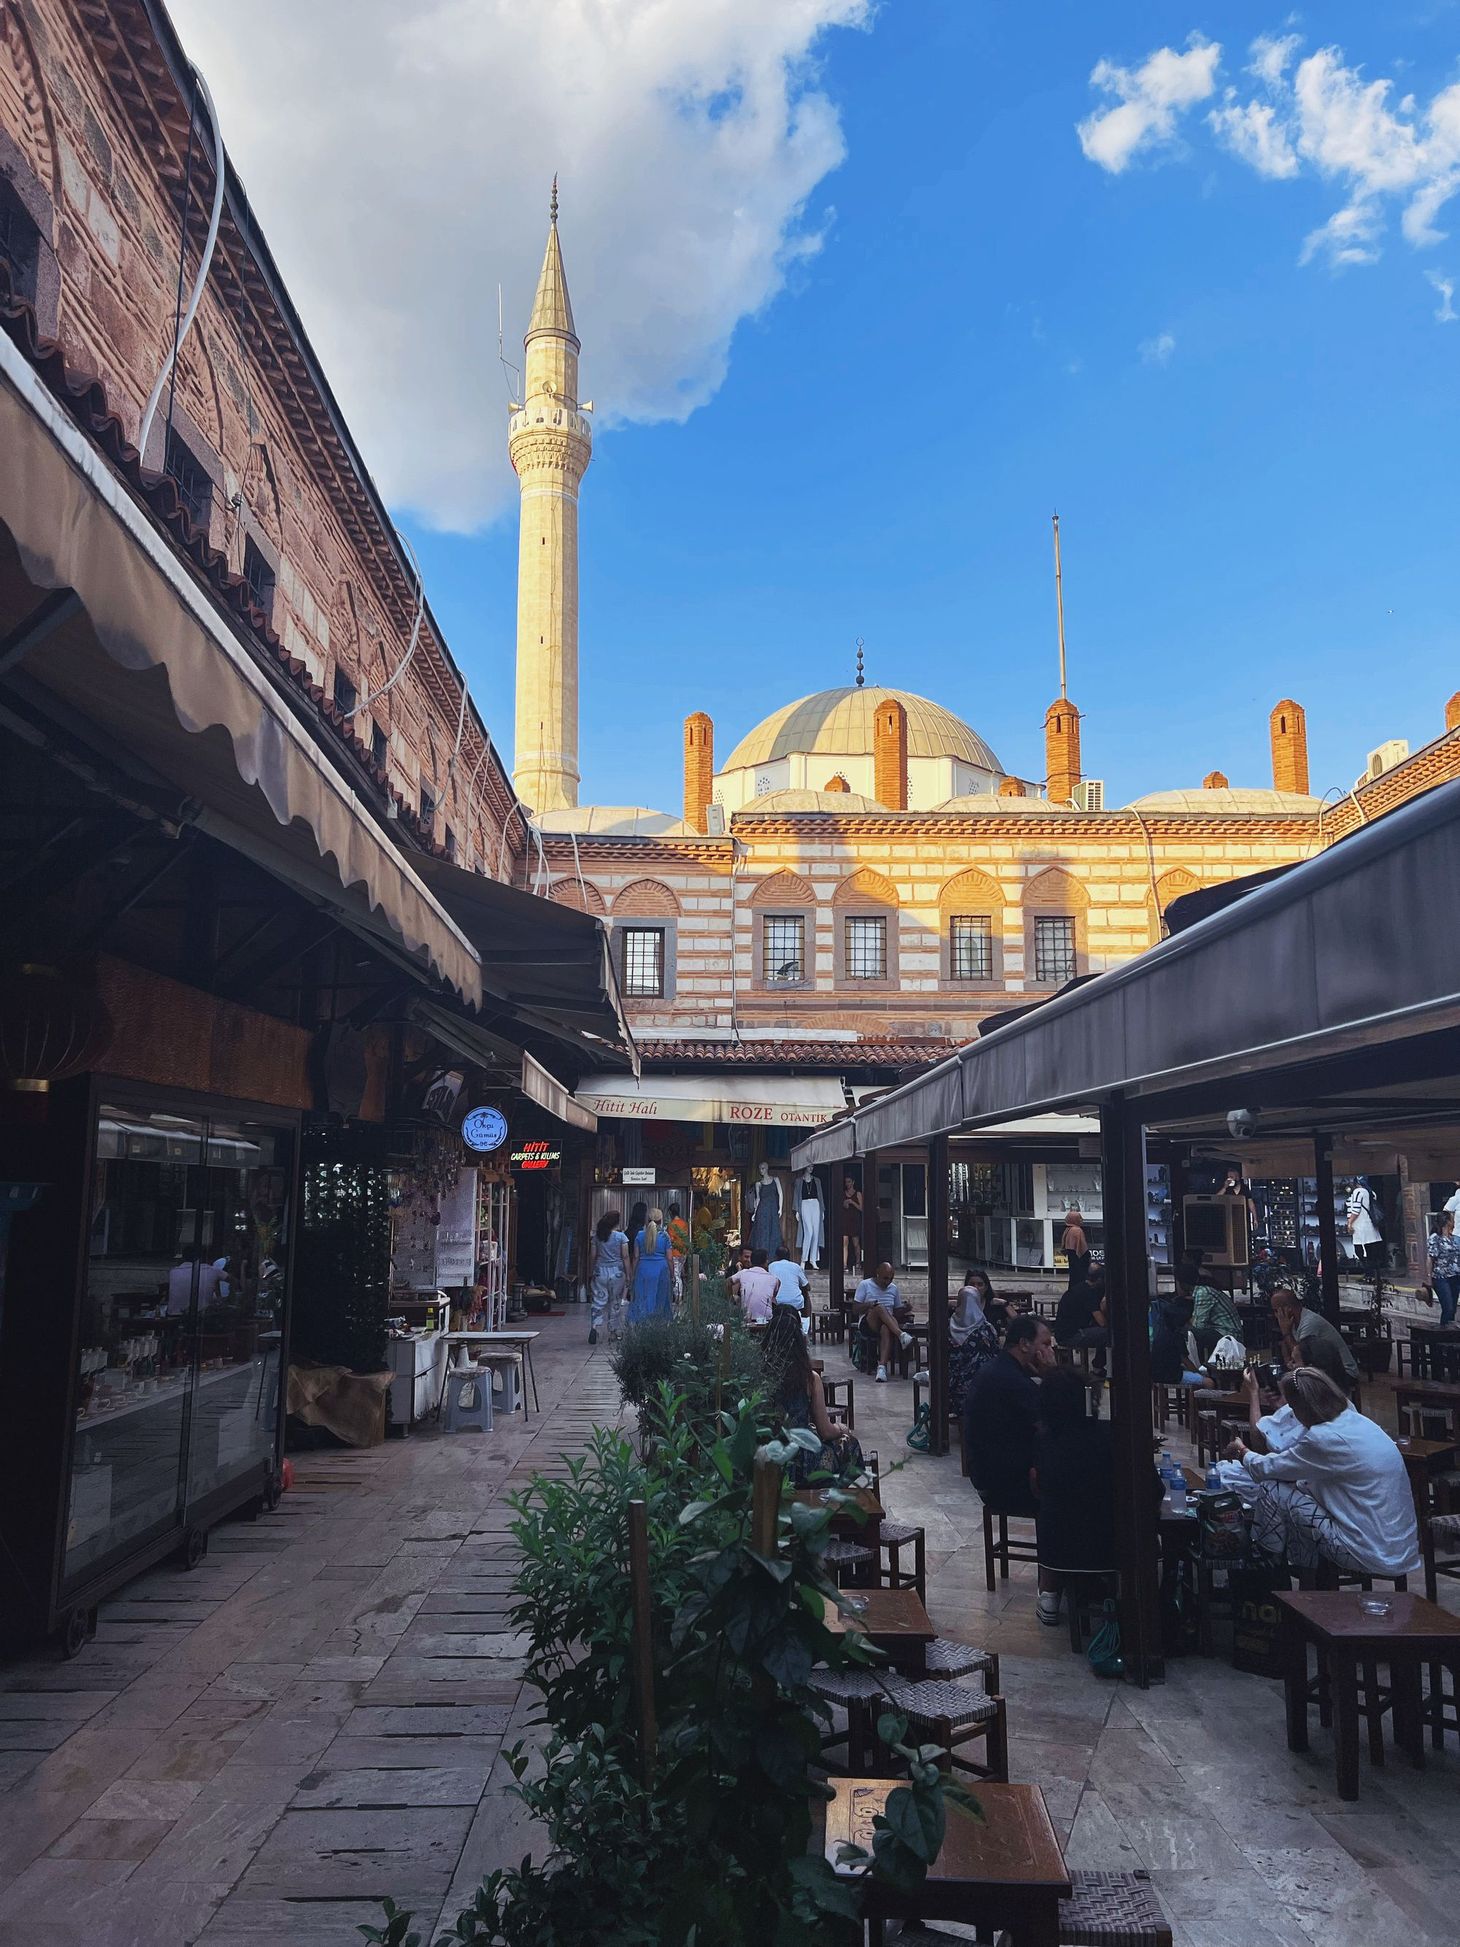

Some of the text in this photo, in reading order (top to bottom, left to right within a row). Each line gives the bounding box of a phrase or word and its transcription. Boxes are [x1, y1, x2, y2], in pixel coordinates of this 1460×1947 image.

[593, 1099, 657, 1115] Hitit Halı
[730, 1106, 773, 1120] ROZE
[511, 1152, 535, 1160] CARPETS
